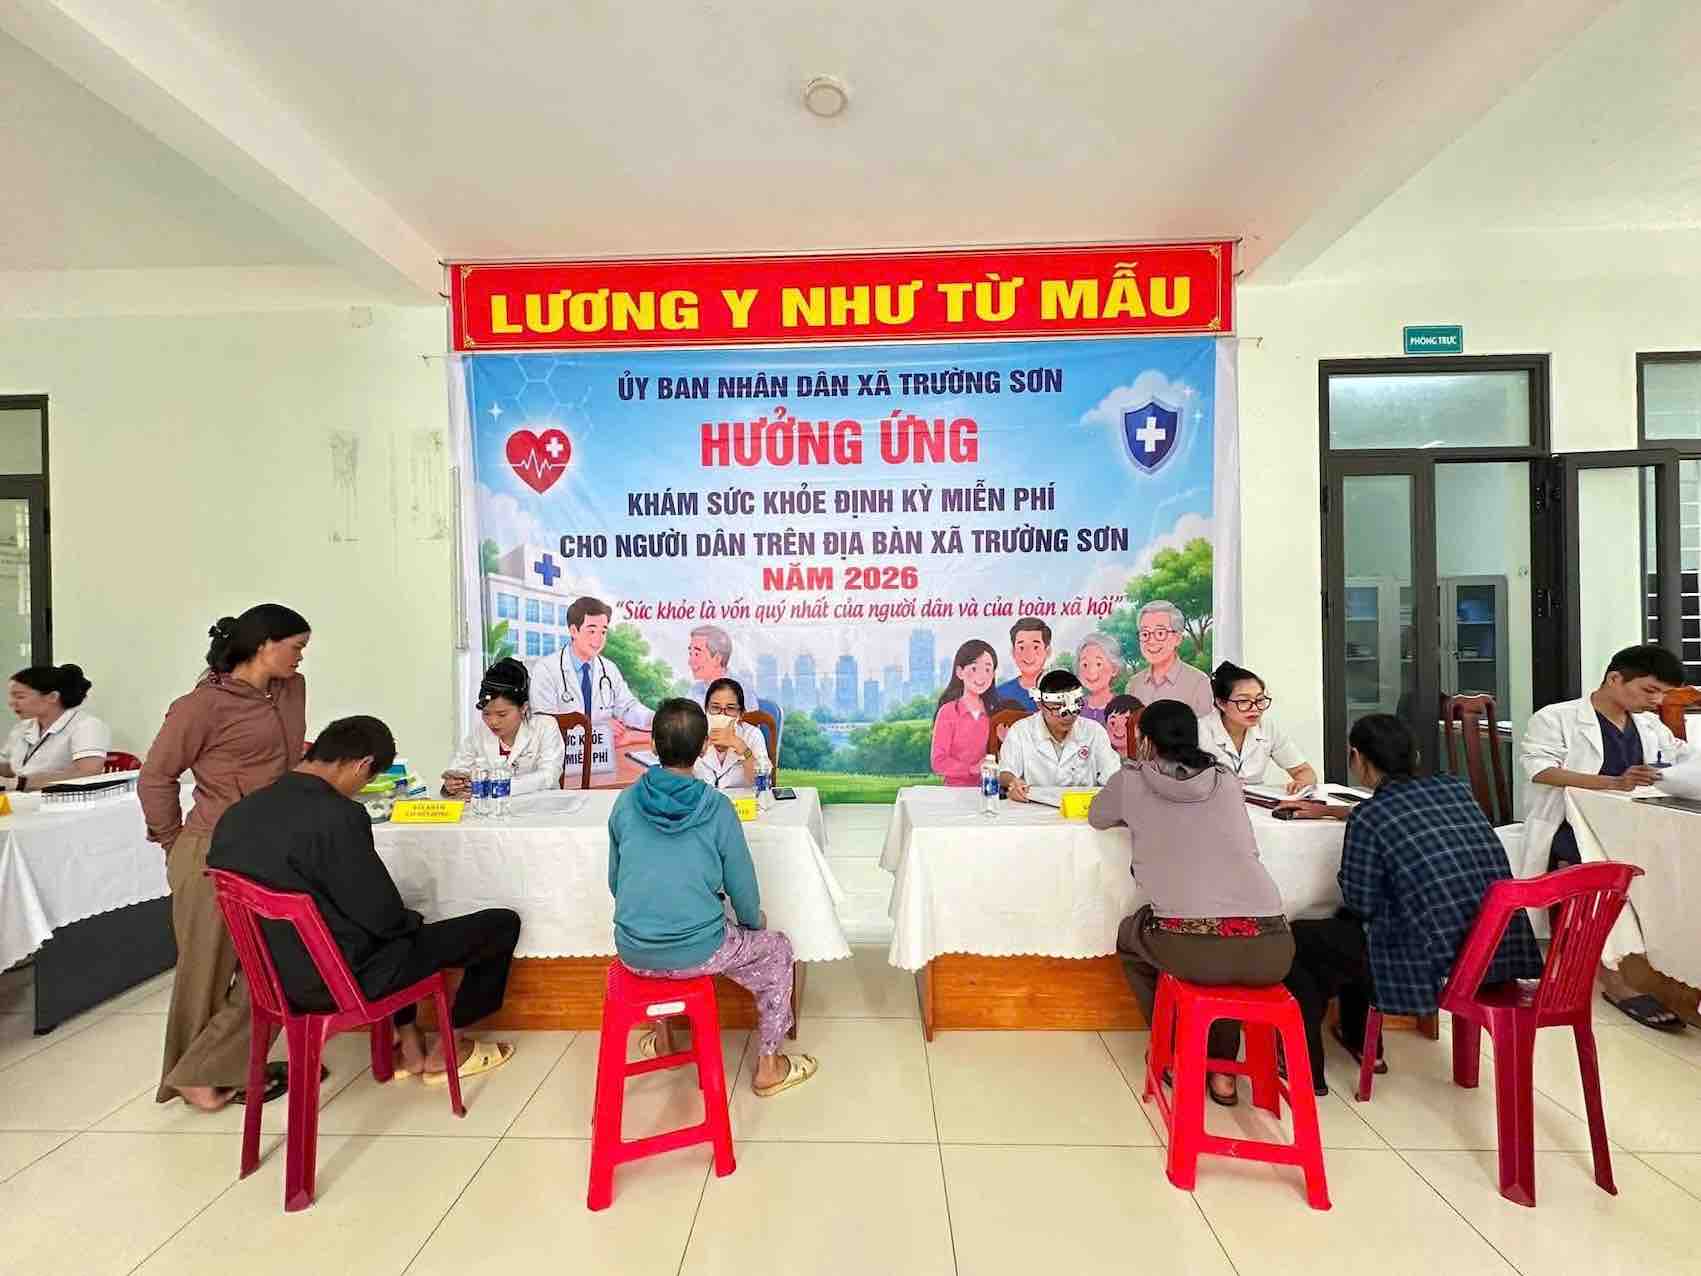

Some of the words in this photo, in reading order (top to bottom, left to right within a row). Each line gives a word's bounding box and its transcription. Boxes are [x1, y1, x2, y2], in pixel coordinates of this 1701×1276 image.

[490, 288, 699, 334] LƯƠNG
[721, 289, 760, 329] Y
[781, 279, 923, 328] NHƯ
[937, 272, 1025, 322] TỪ
[1040, 261, 1192, 320] MẪU
[617, 370, 650, 401] ỦY
[657, 376, 710, 400] BAN
[718, 372, 788, 399] NHÂN
[796, 371, 849, 398] DÂN
[857, 369, 892, 397] XÃ
[899, 368, 1001, 396] TRƯỜNG
[1010, 368, 1063, 393] SƠN
[700, 406, 863, 467] HƯỞNG
[880, 409, 979, 464] ỨNG
[628, 487, 698, 516] KHÁM
[707, 487, 755, 515] SỨC
[763, 482, 826, 515] KHỎE
[834, 488, 894, 520] ĐỊNH
[902, 484, 932, 513] KỲ
[941, 479, 1005, 513] MIỄN
[1013, 481, 1056, 511] PHÍ
[560, 535, 608, 559] CHO
[616, 528, 688, 558] NGƯỜI
[695, 528, 745, 557] DÂN
[753, 528, 815, 556] TRÊN
[822, 529, 864, 562] ĐỊA
[873, 525, 923, 555] BÀN
[931, 525, 963, 553] XÃ
[971, 523, 1069, 553] TRƯỜNG
[1077, 525, 1129, 551] SƠN
[762, 562, 834, 592] NĂM
[844, 566, 919, 591] 2026
[657, 595, 695, 620] khỏe
[700, 600, 716, 618] là
[721, 595, 751, 619] vốn
[755, 600, 786, 623] quý
[790, 595, 827, 619] nhất
[833, 598, 864, 618] của
[868, 597, 915, 622] người
[921, 597, 952, 618] dân
[959, 598, 977, 617] và
[984, 597, 1013, 617] của
[1018, 596, 1056, 617] toàn
[1060, 597, 1083, 617] xã
[579, 729, 604, 745] KỎE
